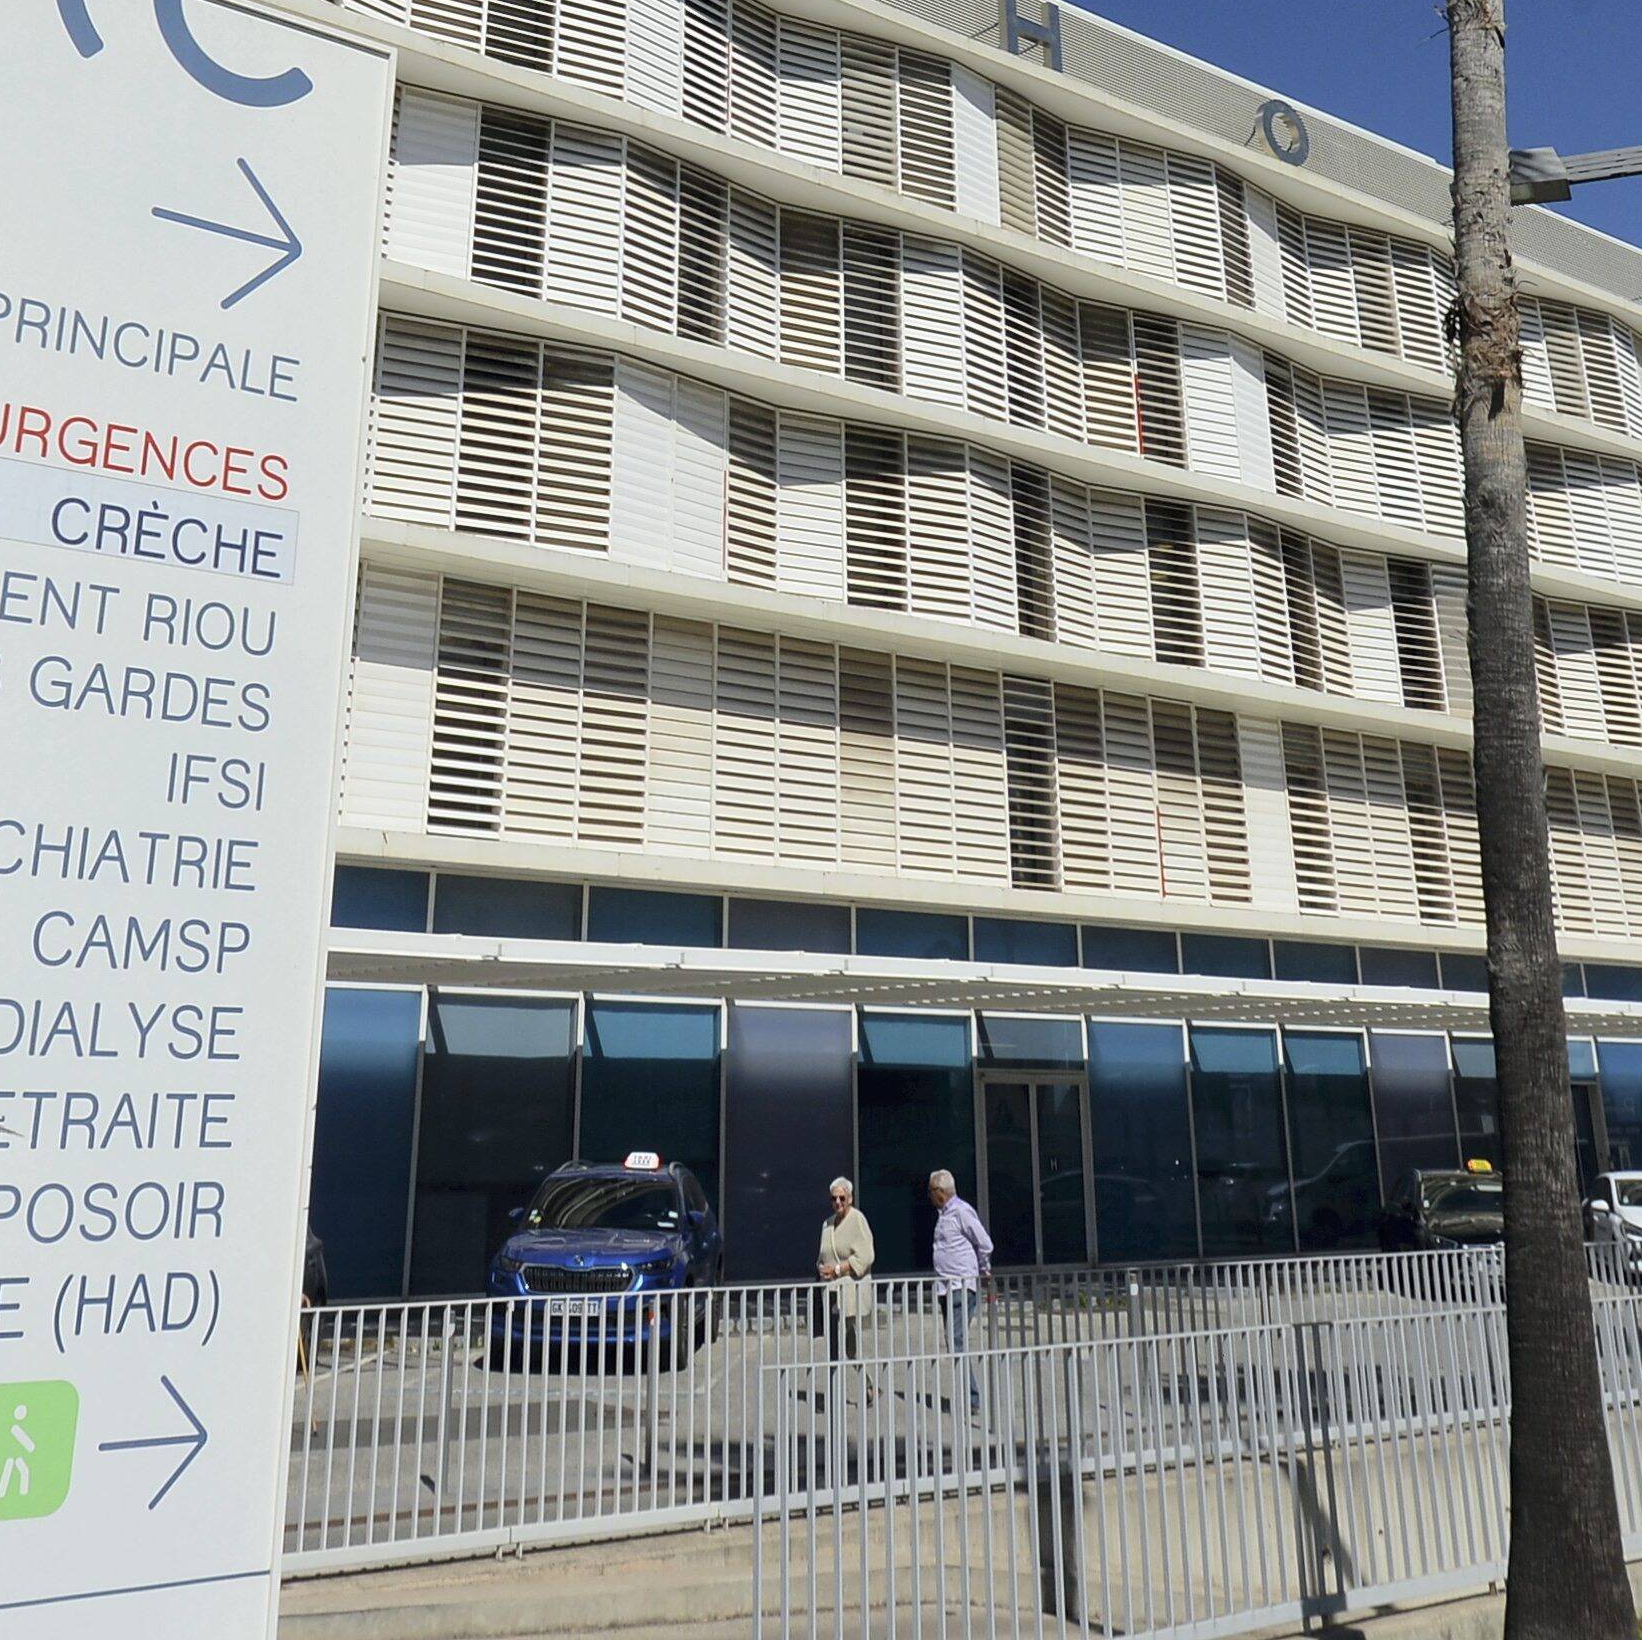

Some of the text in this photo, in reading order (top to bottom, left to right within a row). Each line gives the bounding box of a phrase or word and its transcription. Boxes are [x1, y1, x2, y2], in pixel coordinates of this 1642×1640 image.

[51, 497, 285, 580] CRÈCHE
[143, 593, 277, 657] RIOU
[29, 655, 272, 734] GARDES
[166, 752, 266, 812] IFSI
[31, 910, 251, 974] CAMSP
[52, 1269, 222, 1354] (HAD)
